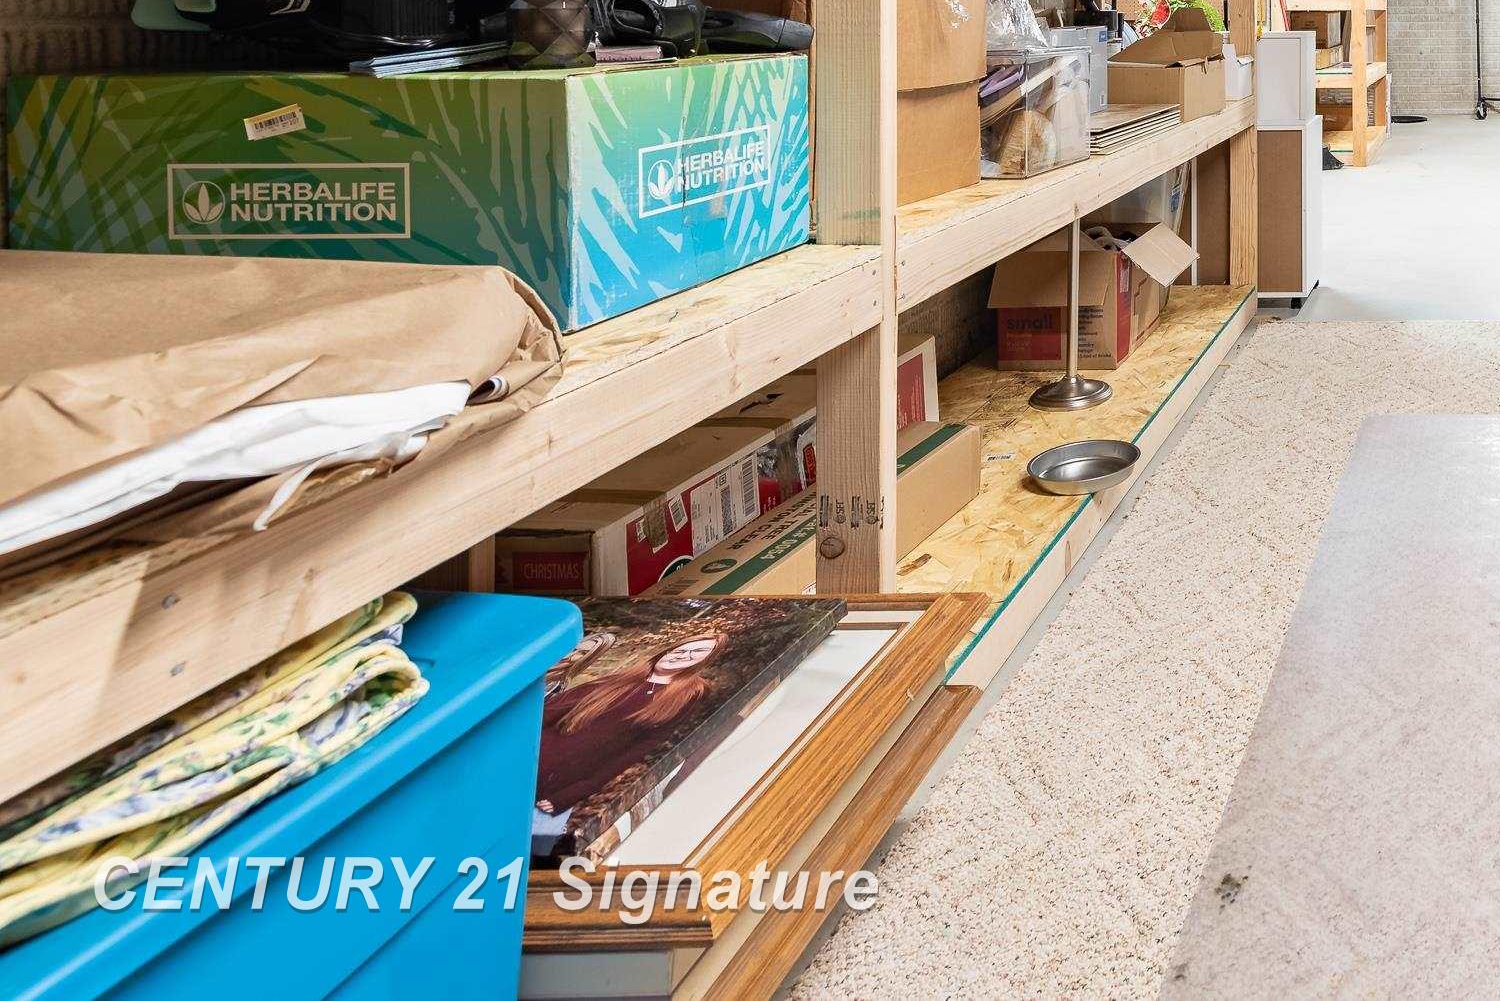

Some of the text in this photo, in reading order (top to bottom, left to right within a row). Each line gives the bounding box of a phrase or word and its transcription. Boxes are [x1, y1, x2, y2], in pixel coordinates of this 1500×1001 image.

[678, 140, 765, 175] HERBALIFE
[675, 157, 766, 193] NUTRITION
[229, 182, 396, 202] HERBALIFE
[229, 202, 398, 223] NUTRITION
[1007, 313, 1053, 330] small
[523, 562, 580, 580] CHRISTMAS
